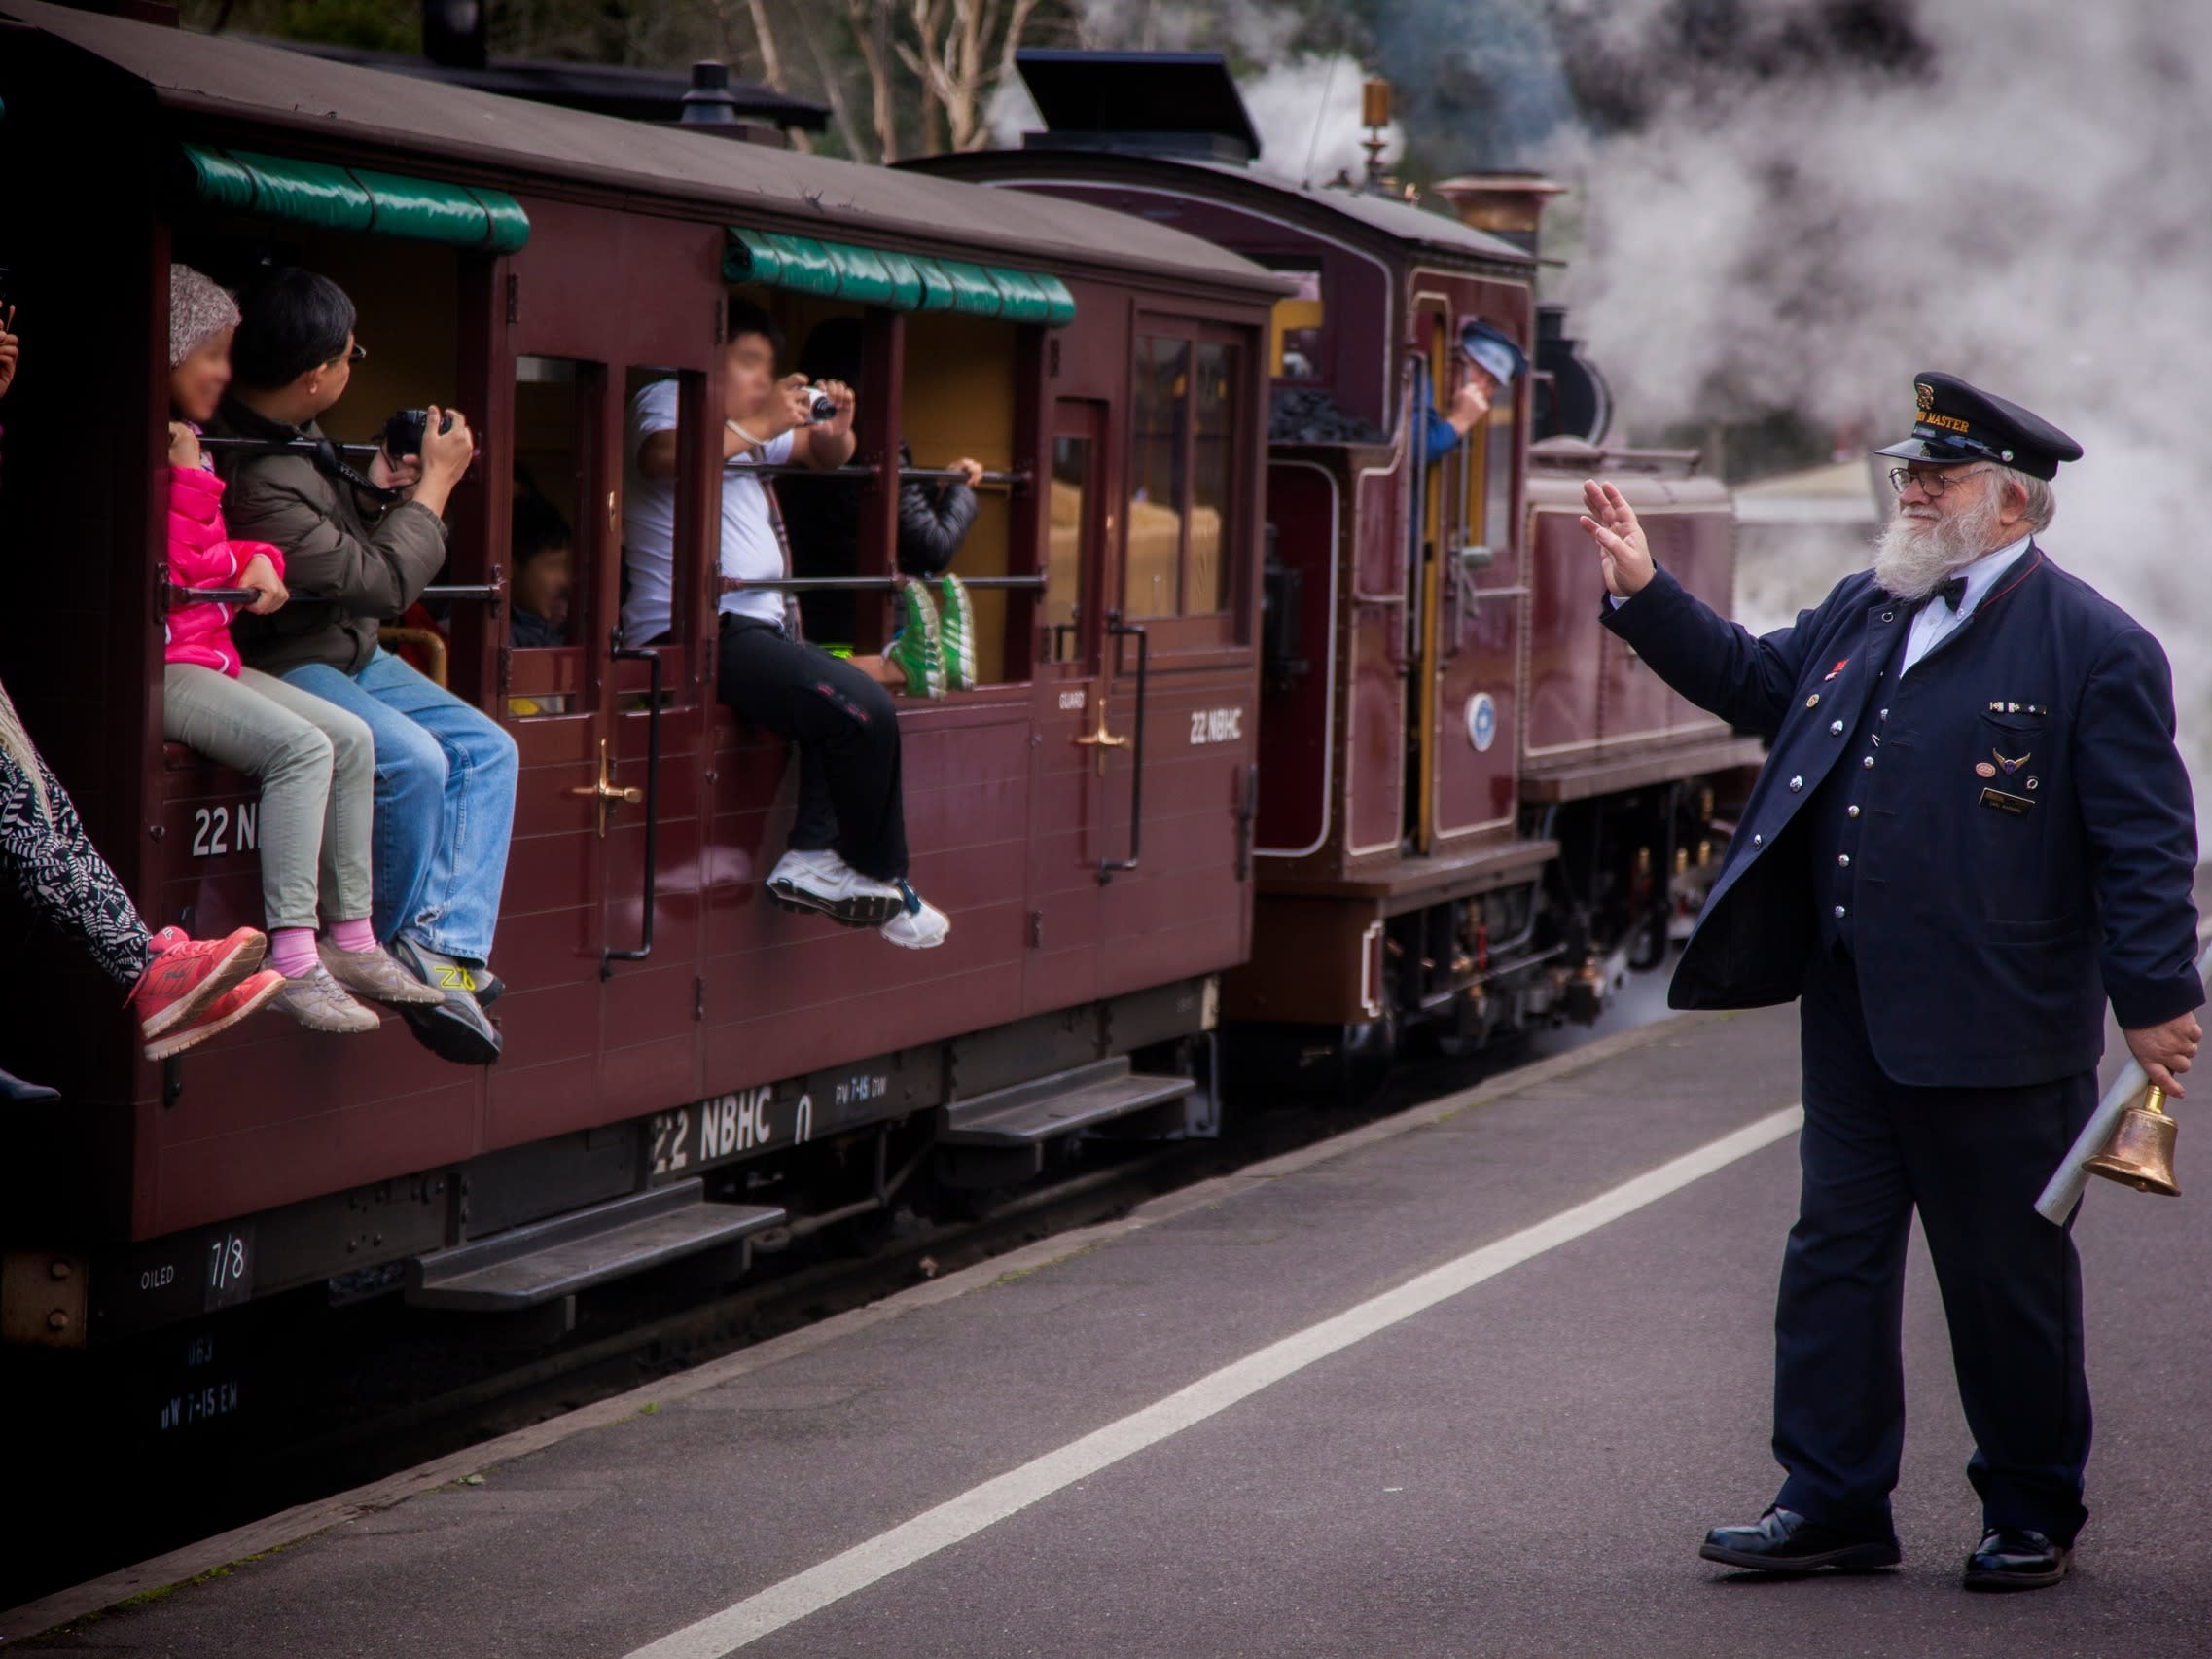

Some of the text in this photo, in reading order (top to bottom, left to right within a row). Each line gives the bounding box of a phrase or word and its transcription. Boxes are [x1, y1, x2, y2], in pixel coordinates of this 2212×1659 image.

[1926, 412, 1969, 433] MASTER
[1190, 708, 1242, 744] 22 NBHC
[193, 801, 262, 857] 22 N
[699, 1084, 773, 1162] NBHC
[140, 1265, 174, 1290] OILED
[209, 1231, 245, 1290] 7/8
